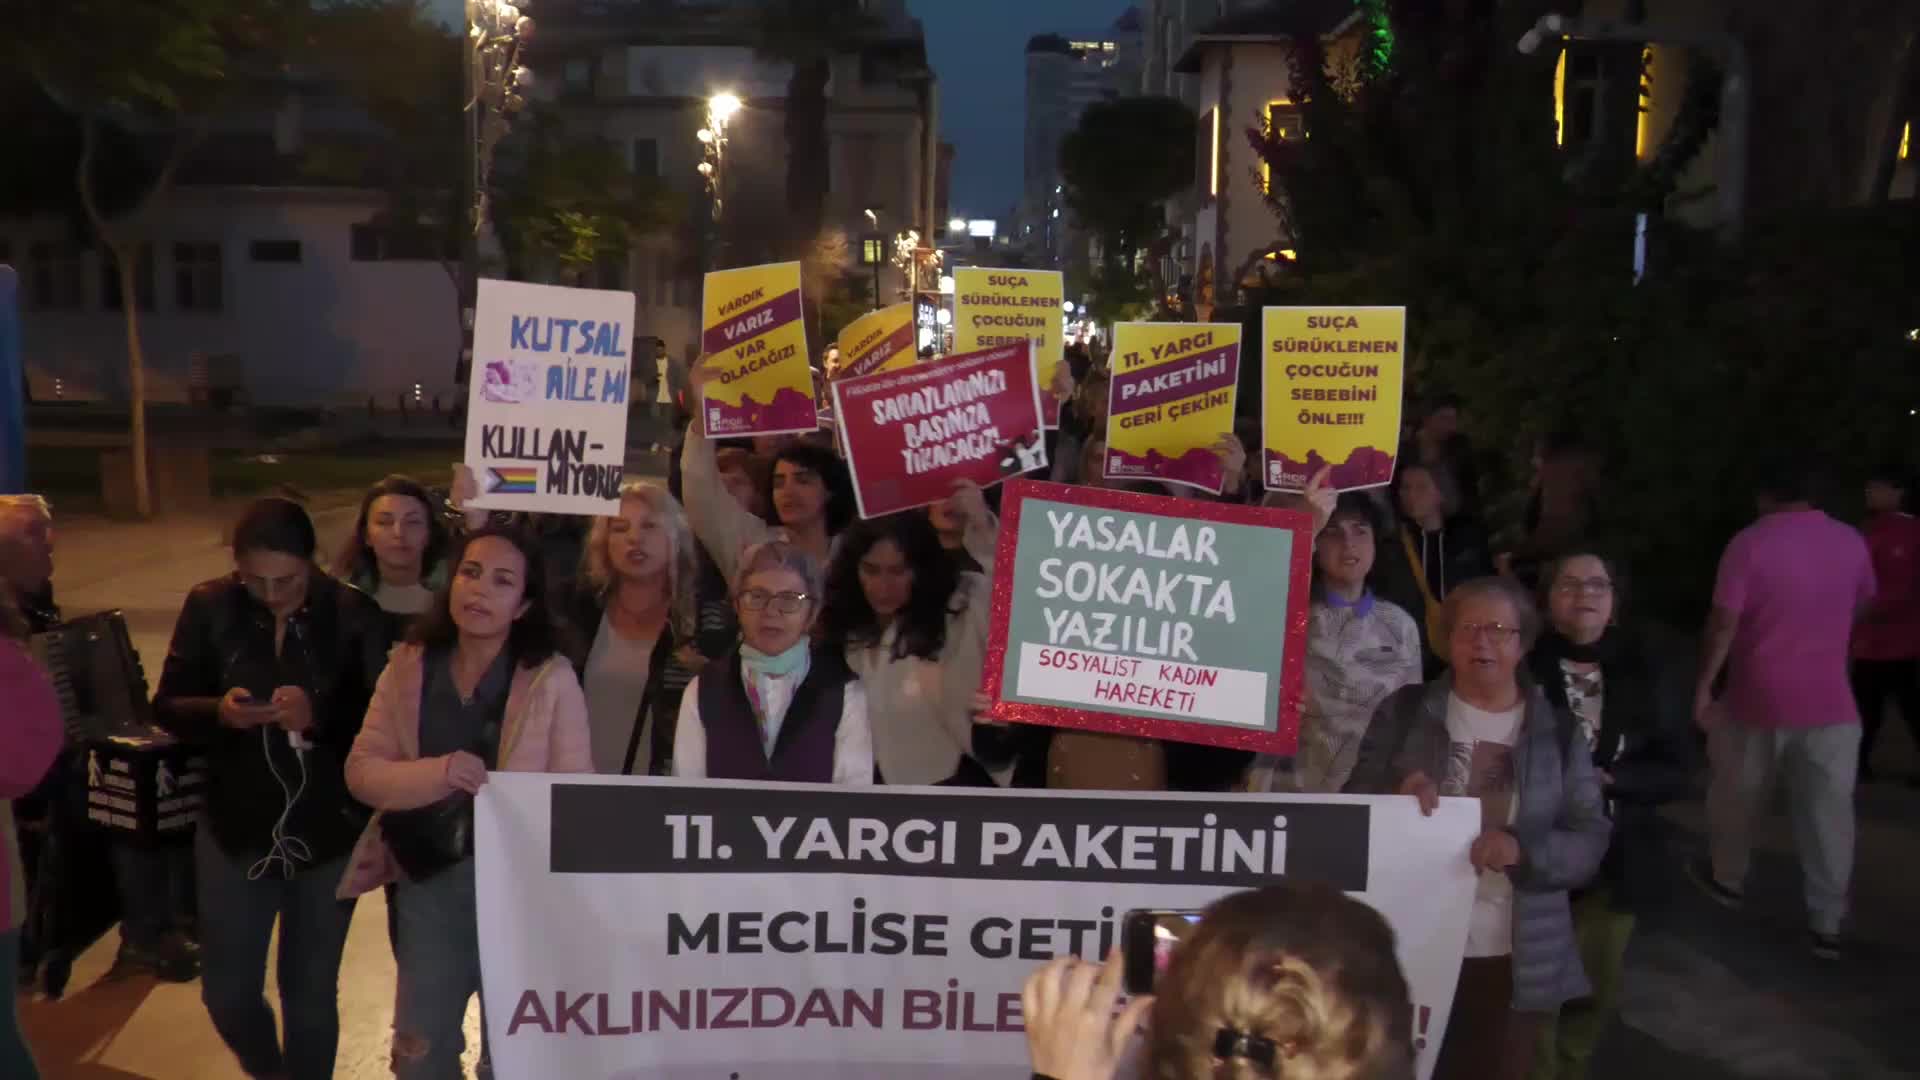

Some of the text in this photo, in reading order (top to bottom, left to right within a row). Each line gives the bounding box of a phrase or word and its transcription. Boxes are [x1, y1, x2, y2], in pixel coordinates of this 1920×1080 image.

[718, 286, 765, 316] VARDIK
[988, 275, 1029, 289] SUÇA
[511, 315, 626, 357] KUTSAL
[724, 309, 775, 341] VARIZ
[1307, 316, 1359, 333] SUÇA
[736, 339, 766, 361] VAR
[1123, 331, 1214, 369] 11. YARGI
[1272, 337, 1399, 354] SÜRÜKLENEN
[1122, 353, 1227, 400] PAKETİNİ
[1285, 362, 1379, 381] ÇOCUĞUN
[1120, 392, 1229, 430] GERİ ÇEKİN!
[1291, 385, 1377, 402] SEBEBİNİ
[1297, 408, 1365, 425] ÖNLE!!!
[1047, 511, 1219, 566] YASALAR
[1036, 558, 1237, 624] SOKAKTA
[1043, 607, 1199, 662] YAZILIR
[1039, 649, 1219, 687] SOSYALİST KADIN
[1094, 680, 1197, 713] HAREKETİ
[665, 813, 1288, 875] 11. YARGI PAKETİNİ
[666, 897, 949, 957] MECLİSE
[506, 978, 1026, 1036] AKLINIZDAN BİLE
